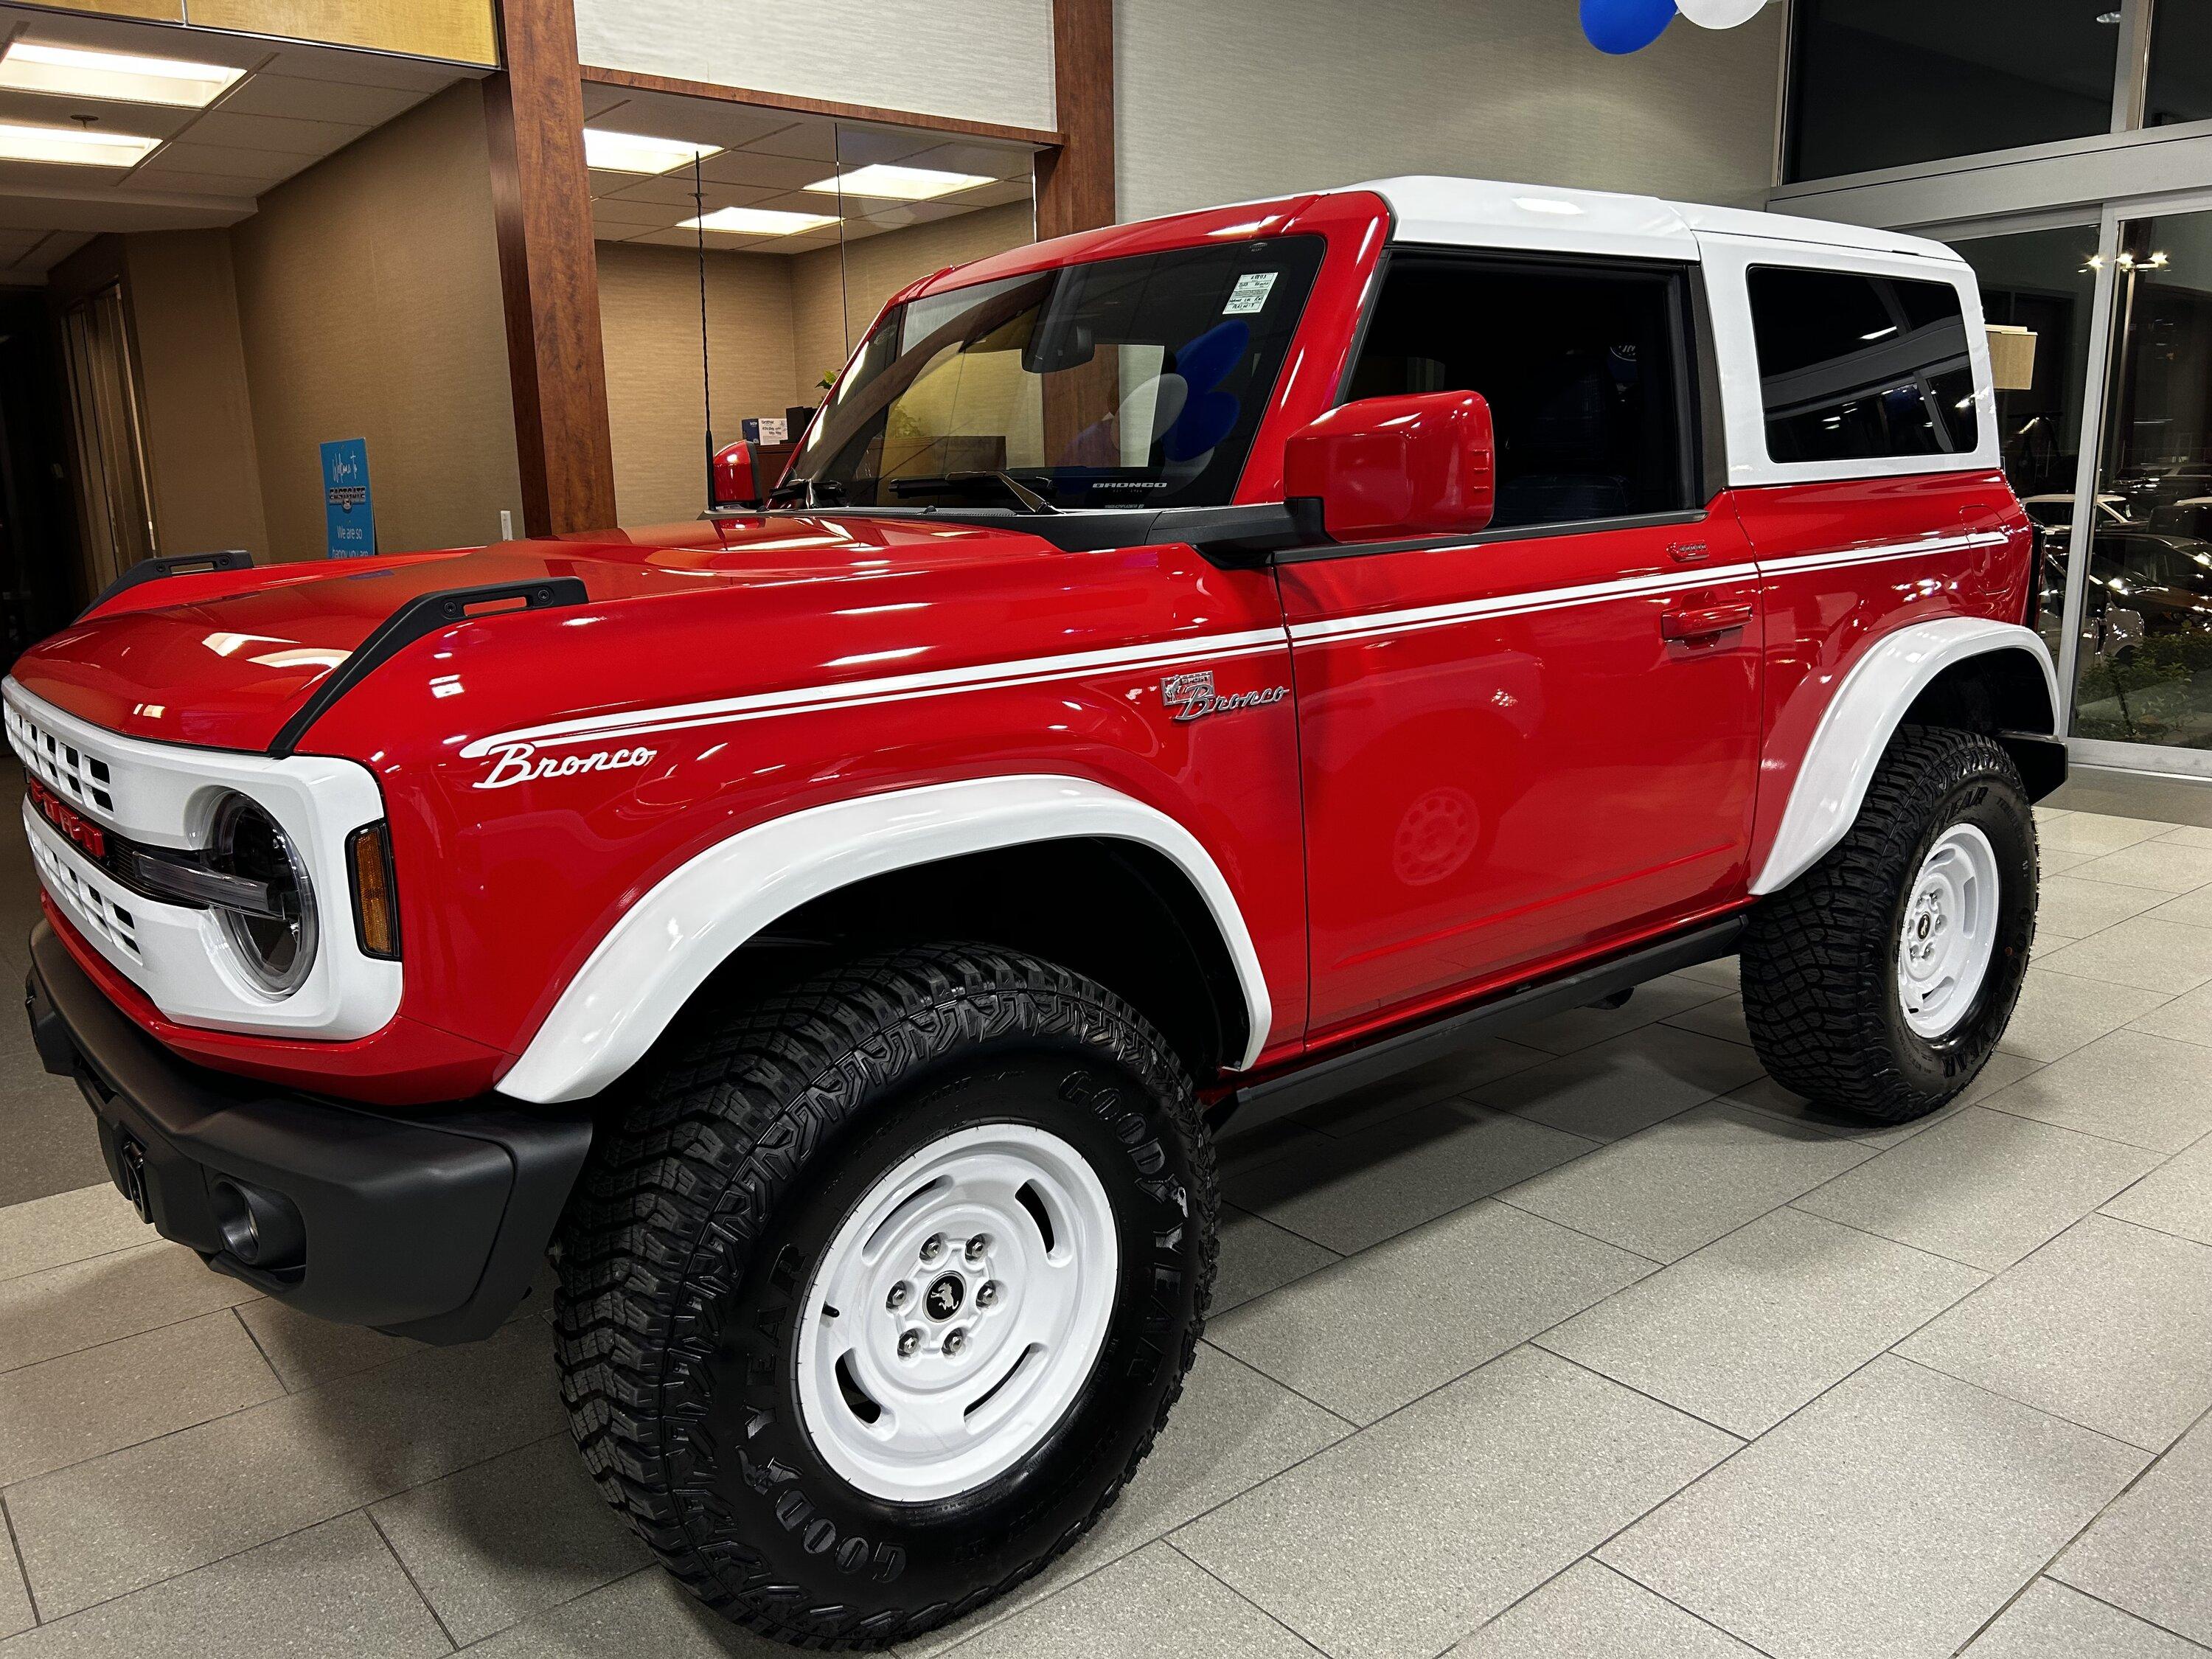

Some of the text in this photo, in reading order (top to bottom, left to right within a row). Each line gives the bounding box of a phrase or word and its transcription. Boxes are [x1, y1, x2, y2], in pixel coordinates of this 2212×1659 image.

[337, 525, 363, 540] We are so
[1181, 675, 1211, 684] SPORT
[1175, 683, 1290, 720] Bronco
[472, 742, 657, 788] Bronco
[1057, 1068, 1189, 1386] GOODYEAR
[733, 1243, 907, 1584] GOODYEAR
